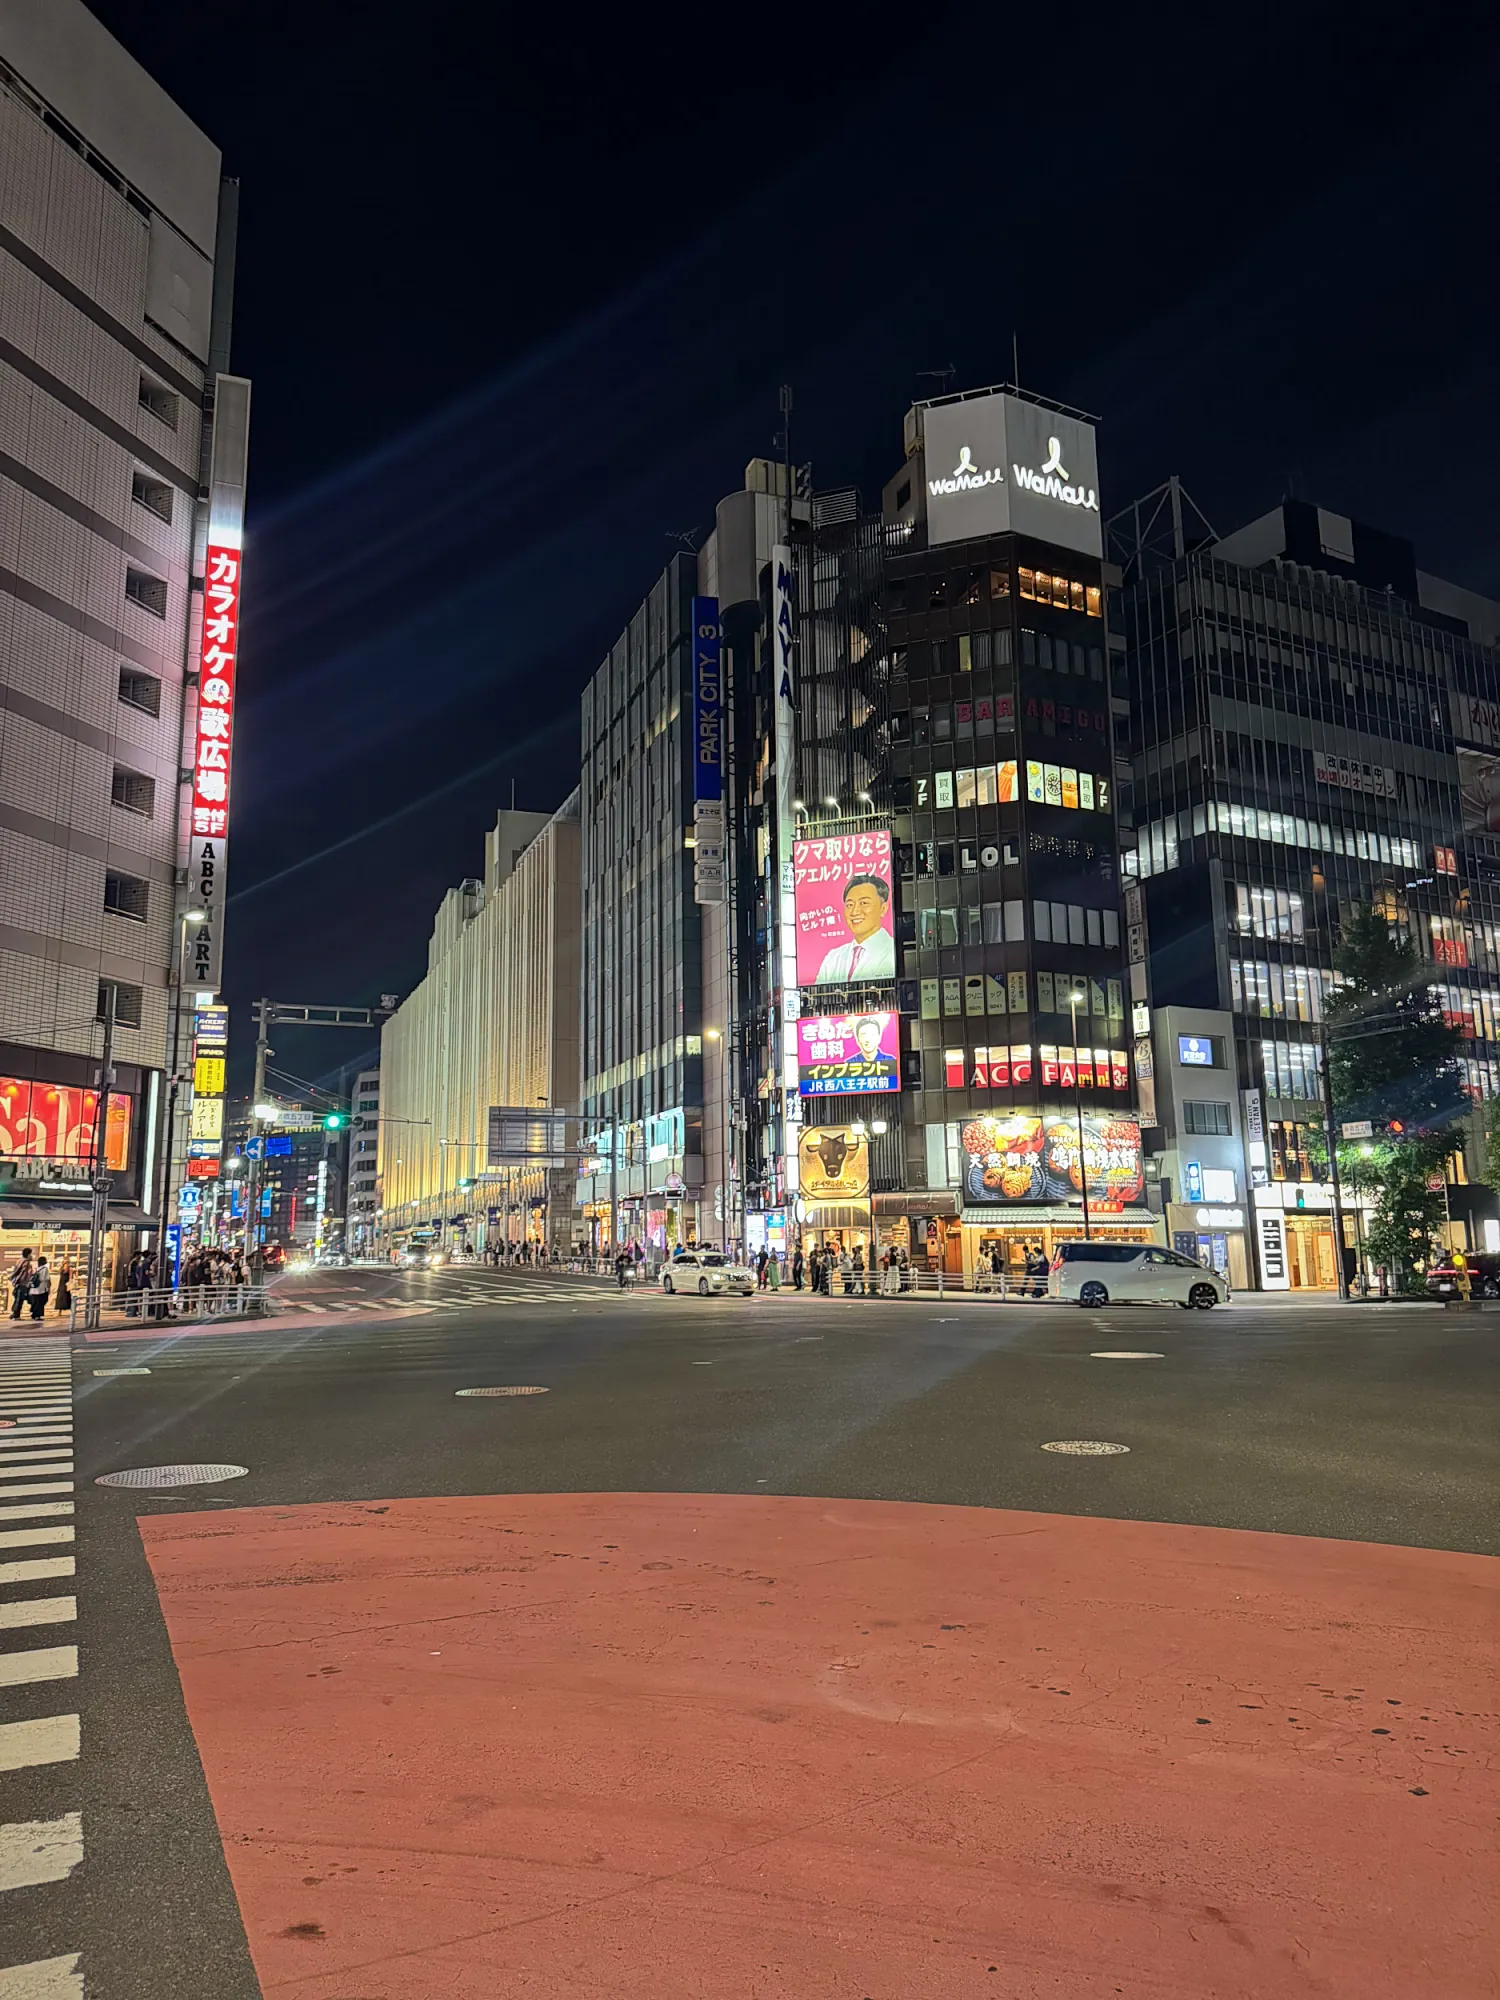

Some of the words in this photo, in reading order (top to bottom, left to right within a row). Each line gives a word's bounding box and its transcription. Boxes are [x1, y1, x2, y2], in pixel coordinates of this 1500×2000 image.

[204, 553, 237, 675] カラオケ
[699, 624, 716, 640] 3
[699, 652, 717, 702] CITY
[956, 699, 1013, 723] BAR
[700, 708, 718, 765] PARK
[197, 706, 230, 803] 歌広場
[917, 779, 927, 806] 7F
[938, 778, 950, 802] 買取
[1082, 779, 1092, 804] 買取
[1099, 781, 1108, 807] 7F
[194, 821, 225, 834] 5F
[795, 833, 890, 865] クマ取りなら
[961, 844, 1019, 868] LOL
[794, 858, 891, 885] アエルクリニック
[1438, 943, 1464, 964] 会計
[802, 1020, 853, 1042] きぬた
[810, 1040, 845, 1060] 歯科
[808, 1061, 889, 1079] インプラント
[1114, 1069, 1128, 1087] 3F
[808, 1077, 890, 1093] JR西八王子駅前
[1251, 1097, 1259, 1105] 5
[197, 1101, 207, 1138] ルノアール
[1252, 1106, 1261, 1134] ISETAN
[16, 1156, 92, 1181] ABC-MA
[33, 1222, 61, 1230] ABC-MART
[111, 1223, 136, 1231] ABC-MART
